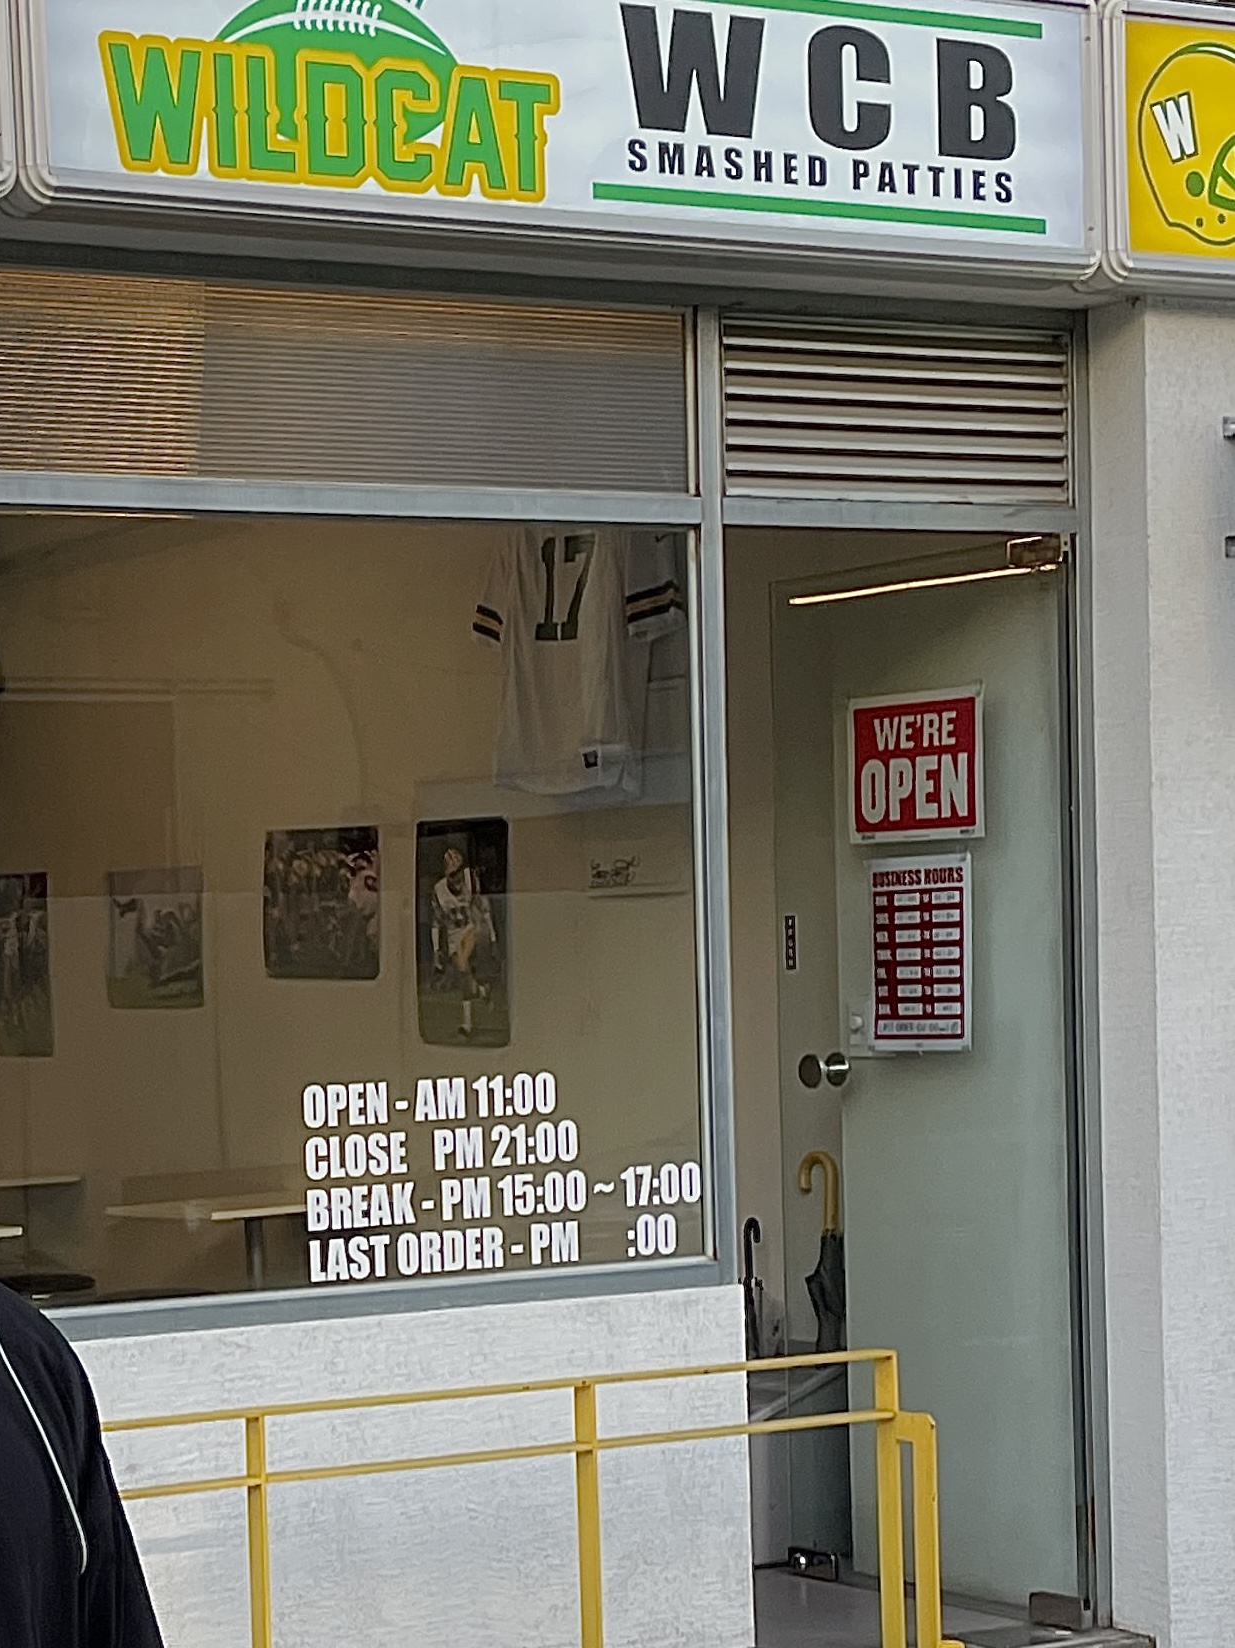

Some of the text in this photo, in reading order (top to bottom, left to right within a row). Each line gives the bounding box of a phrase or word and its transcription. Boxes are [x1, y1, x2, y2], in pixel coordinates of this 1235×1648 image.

[100, 32, 559, 201] WILDCAT
[1150, 91, 1199, 164] W
[628, 138, 1013, 203] SMASHED PATTIES
[535, 532, 596, 640] 17
[873, 710, 956, 751] WE'RE
[861, 752, 968, 824] OPEN
[924, 866, 963, 886] HOURS
[303, 1081, 388, 1128] OPEN
[415, 1077, 466, 1122] AM
[472, 1071, 557, 1118] 11:00
[305, 1119, 578, 1180] CLOSE PM 21:00
[306, 1181, 416, 1232] BREAK
[441, 1176, 491, 1221] PM
[497, 1169, 586, 1216] 15:00
[620, 1162, 701, 1207] 17:00
[309, 1234, 390, 1283] LAST
[397, 1226, 504, 1276] ORDER
[530, 1221, 579, 1265] PM
